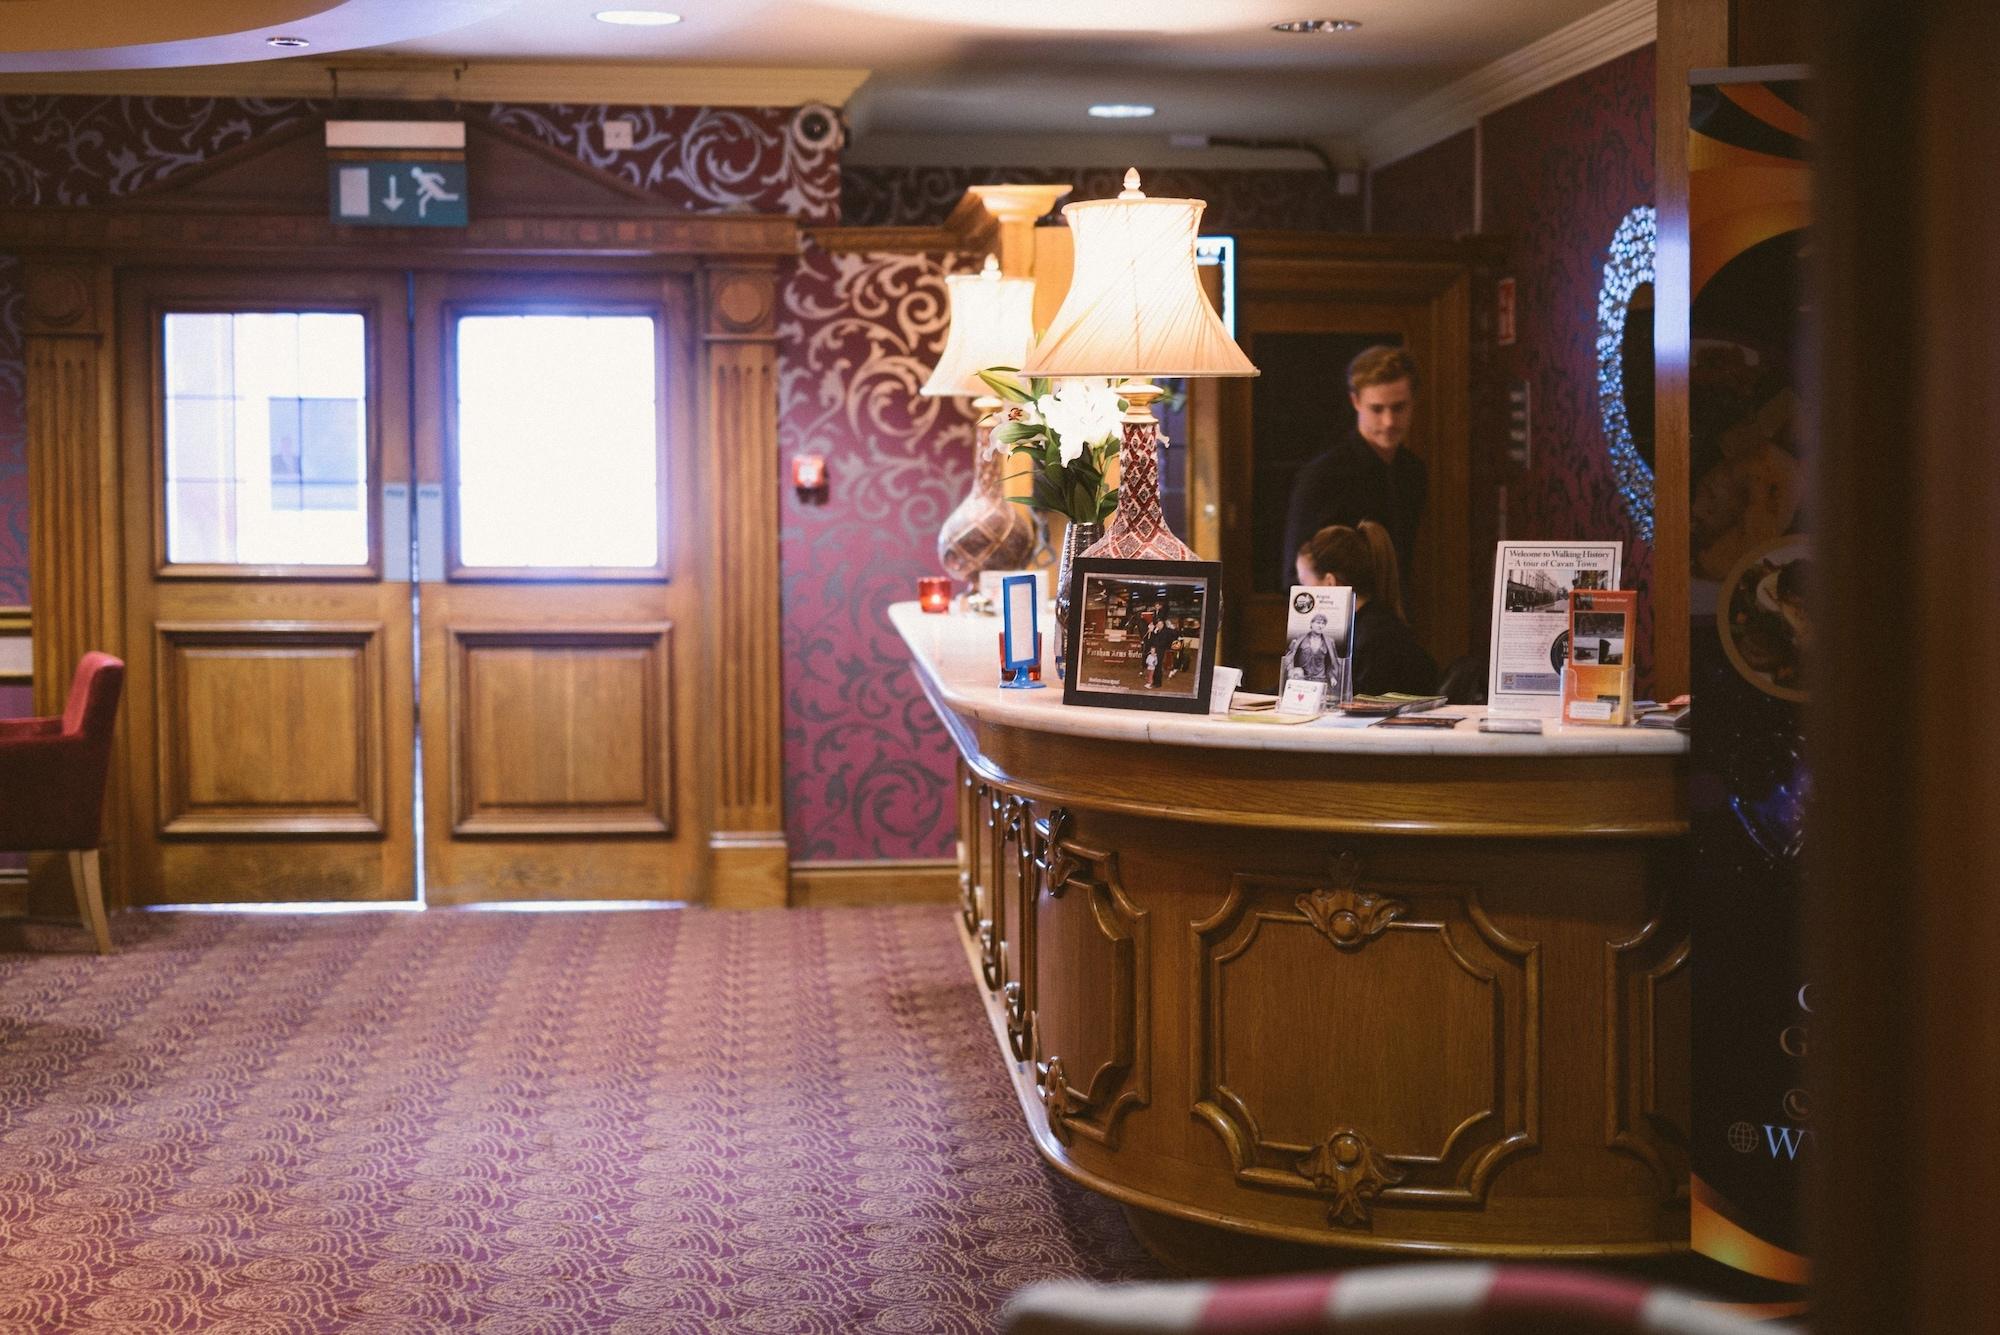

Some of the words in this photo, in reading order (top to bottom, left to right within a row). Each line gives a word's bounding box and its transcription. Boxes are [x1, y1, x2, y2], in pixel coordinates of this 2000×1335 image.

[1510, 550, 1541, 558] Welcome
[1552, 550, 1581, 559] Walking
[1582, 551, 1610, 559] History
[1550, 560, 1574, 568] Cavan
[1577, 560, 1598, 568] Town
